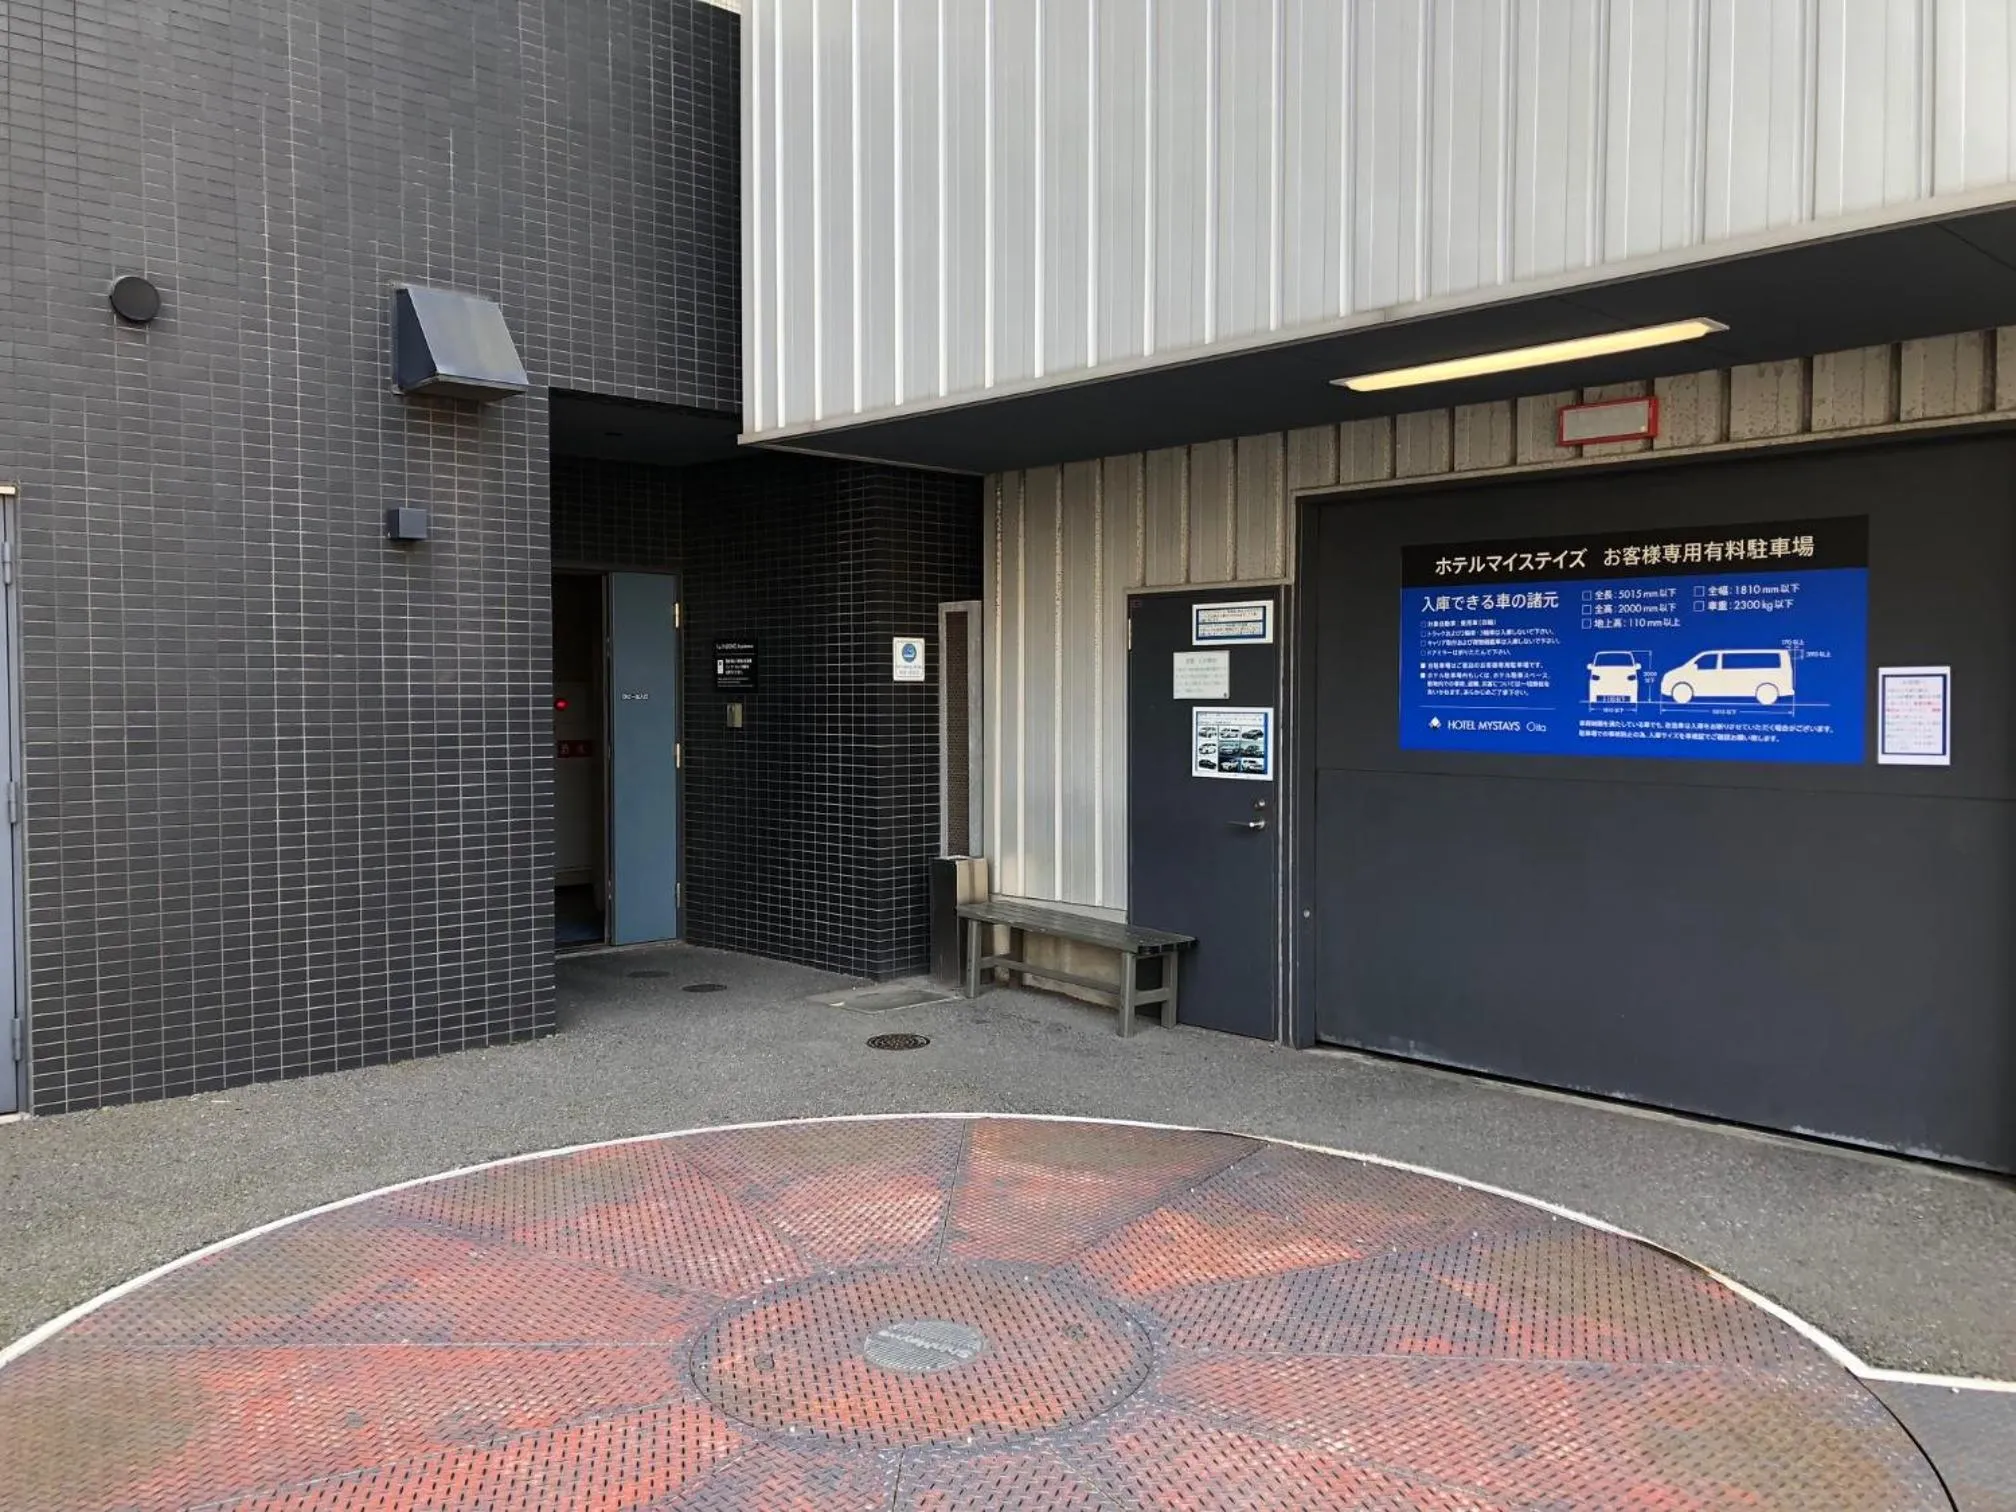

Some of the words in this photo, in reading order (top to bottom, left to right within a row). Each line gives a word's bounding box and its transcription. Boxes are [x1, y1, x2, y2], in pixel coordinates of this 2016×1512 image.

[1435, 548, 1588, 576] ホテルマイステイズ
[1604, 535, 1815, 566] お客様専用有料駐車場
[1421, 591, 1559, 612] 入庫できる車の諸元
[1447, 720, 1476, 731] HOTEL
[1478, 720, 1521, 732] MYSTAYS
[1526, 721, 1547, 733] Oita
